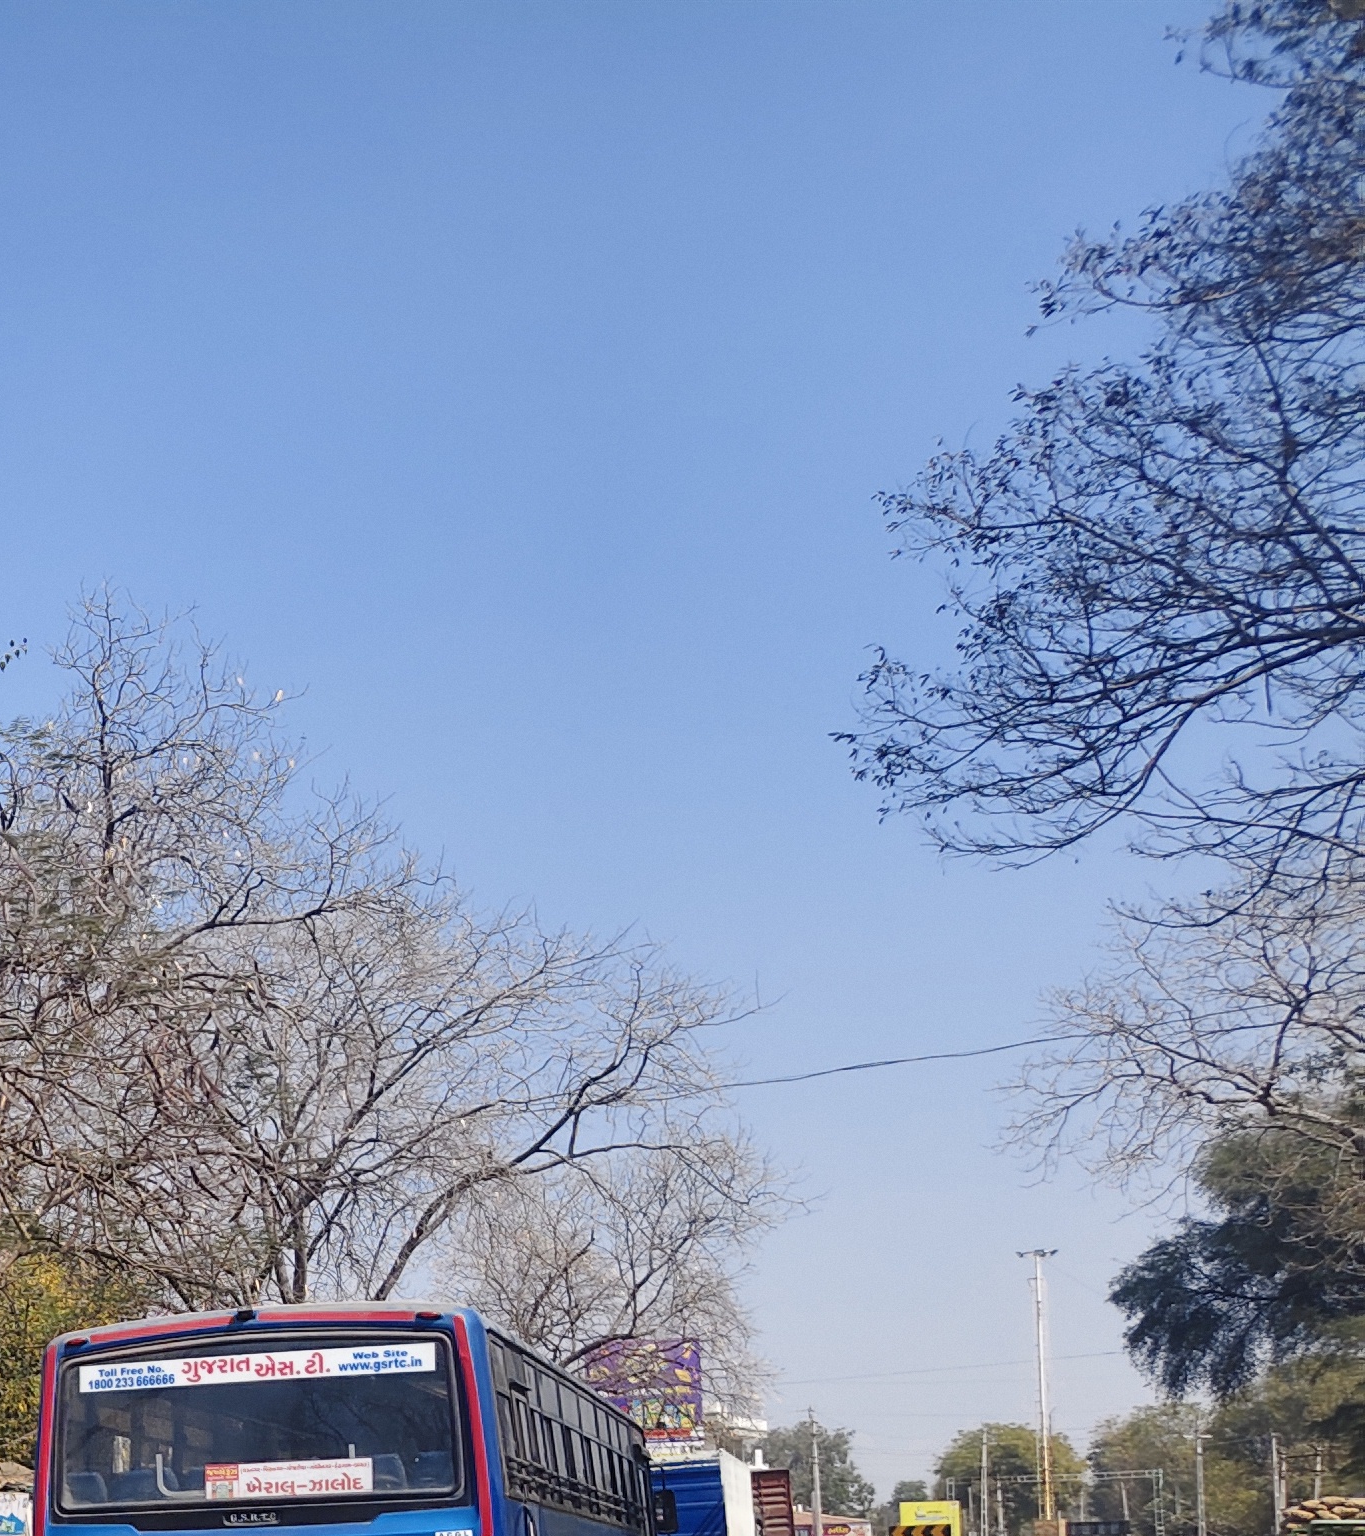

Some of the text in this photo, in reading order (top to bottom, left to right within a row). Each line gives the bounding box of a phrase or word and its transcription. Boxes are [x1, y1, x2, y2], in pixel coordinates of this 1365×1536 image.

[352, 1349, 408, 1360] Web Site
[98, 1364, 165, 1378] Toll Free No.
[181, 1357, 251, 1383] ગુજરાત
[338, 1355, 423, 1373] www.gsrtc.in
[88, 1373, 175, 1390] 1800 233 666666
